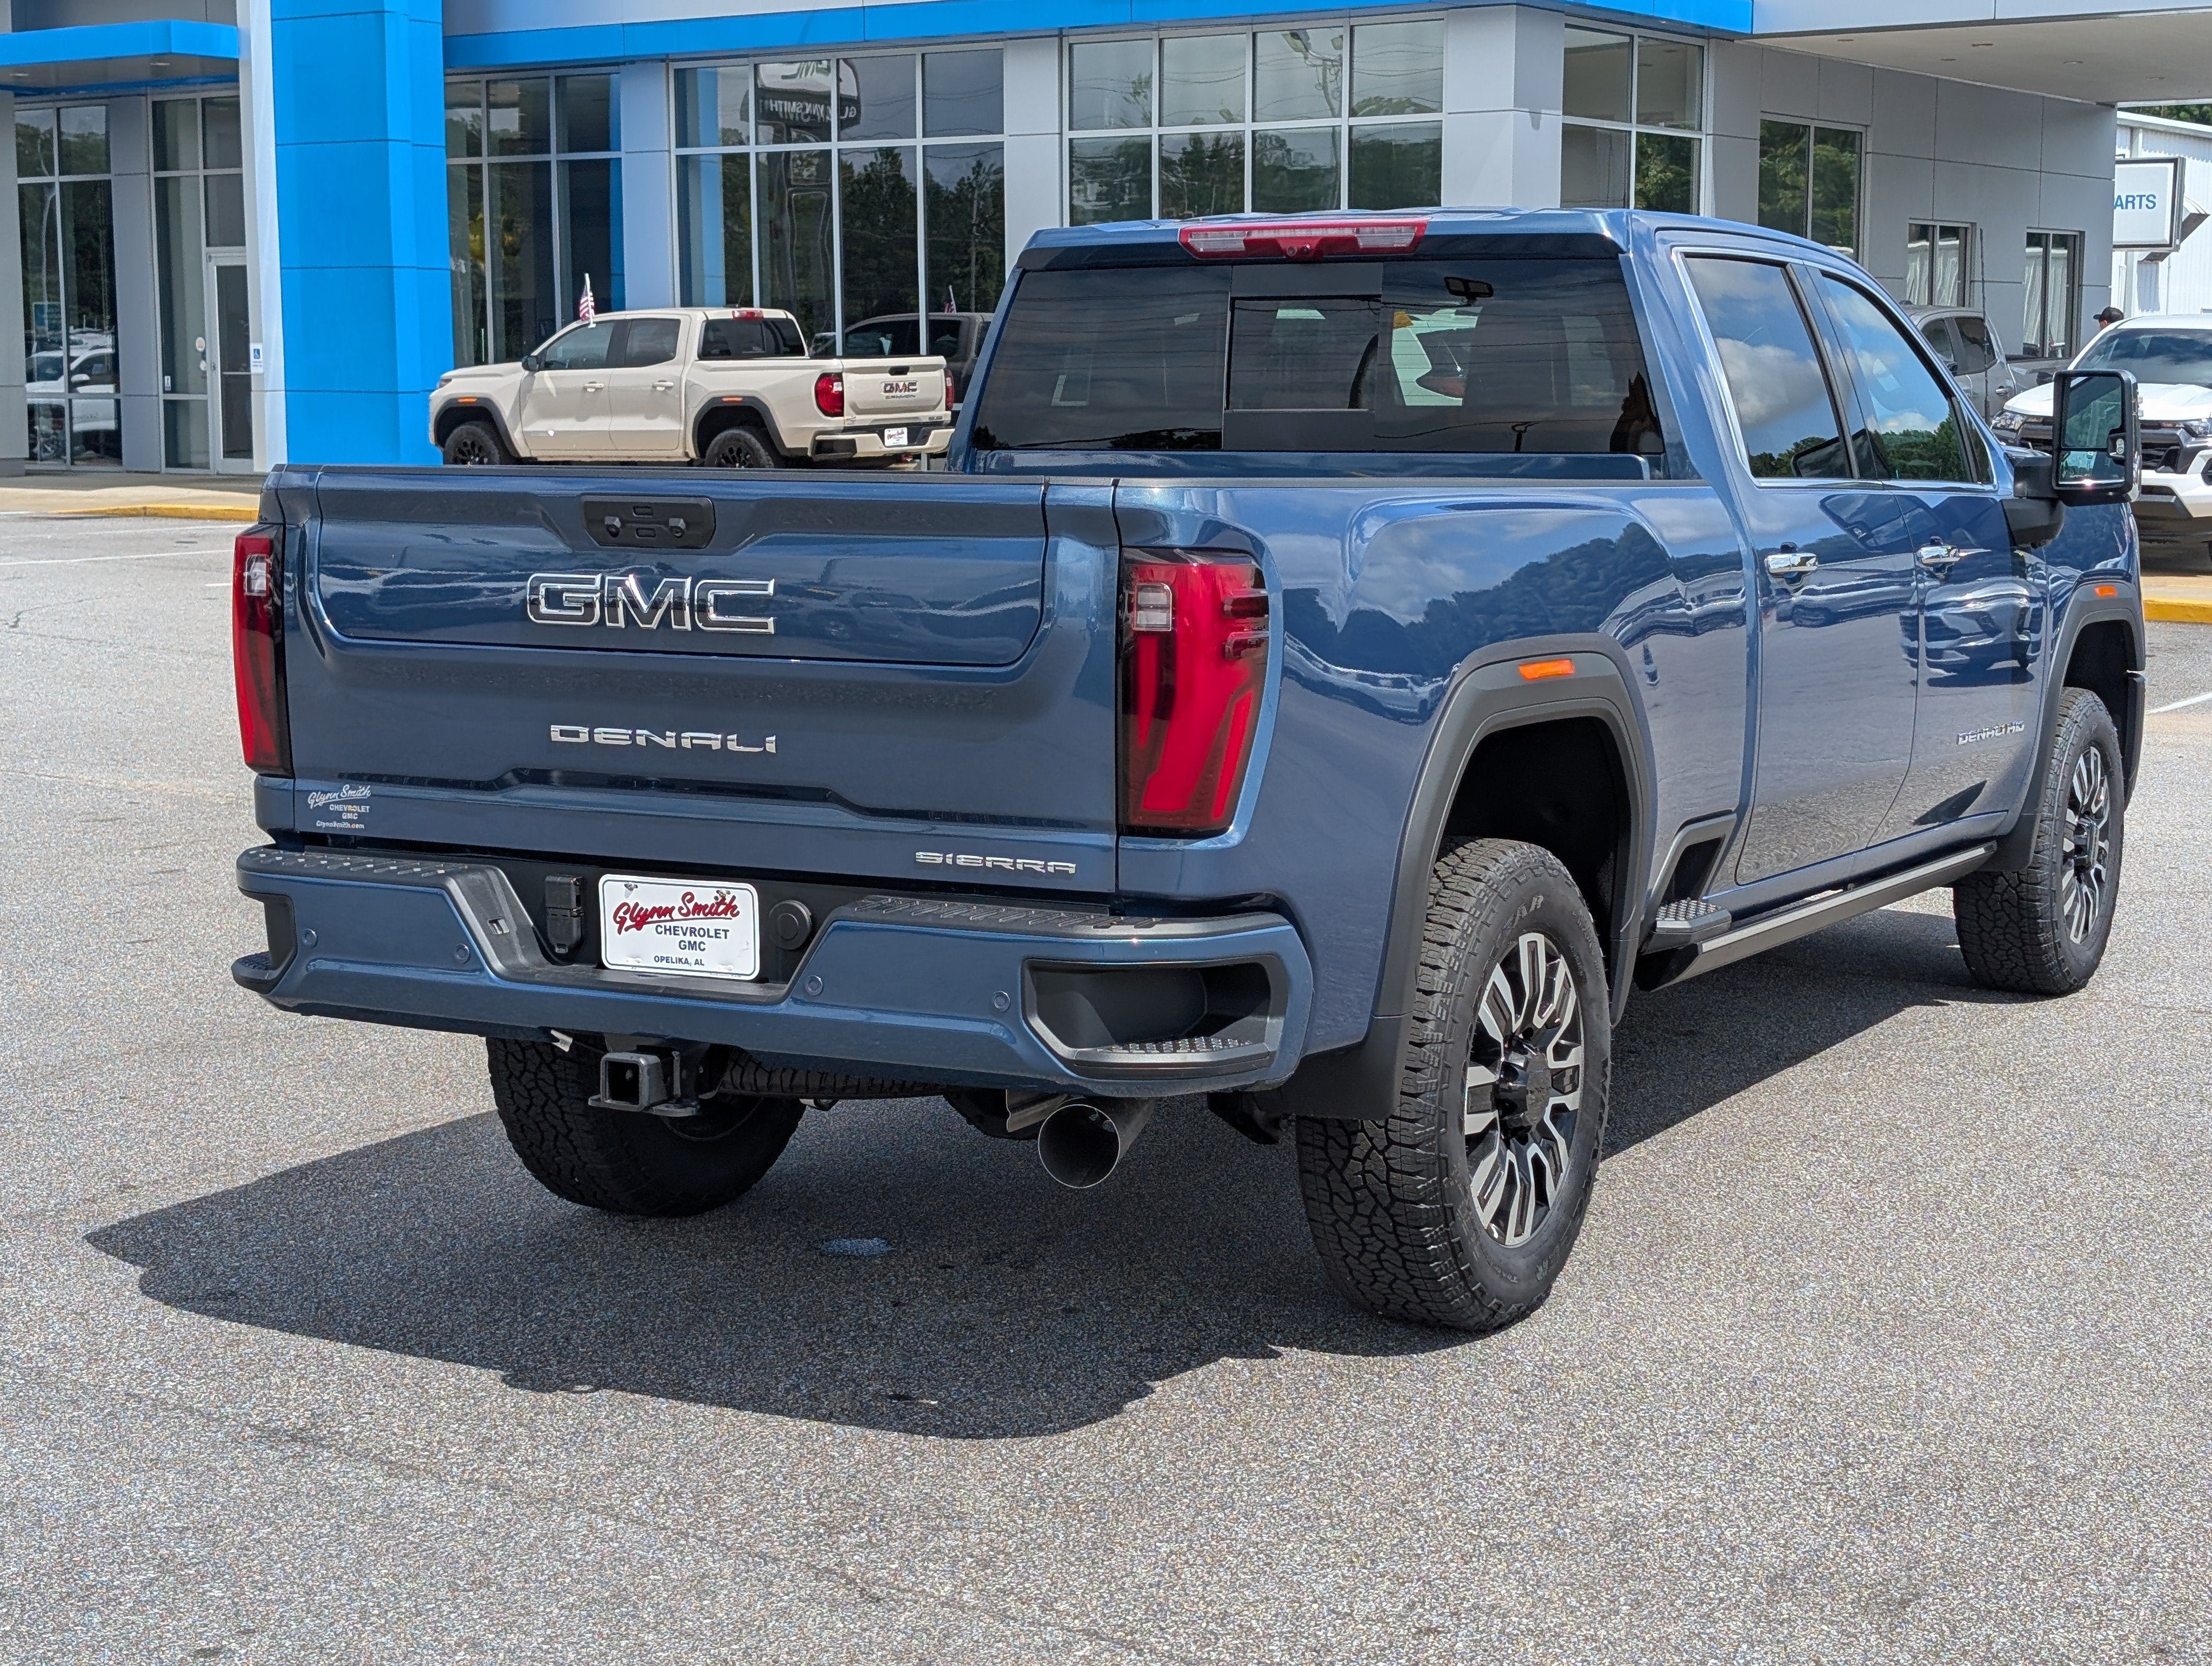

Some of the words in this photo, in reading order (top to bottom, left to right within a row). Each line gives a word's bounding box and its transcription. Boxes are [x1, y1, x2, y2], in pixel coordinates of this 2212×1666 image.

[2113, 194, 2156, 210] ARTS
[884, 381, 917, 393] GMC
[527, 573, 775, 635] GMC
[551, 725, 776, 753] DENALI
[1956, 723, 2006, 745] DENALI
[308, 791, 339, 810] Glynn
[340, 784, 371, 798] Smith
[329, 804, 370, 812] CHEVROLET
[916, 851, 1076, 874] SIERRA
[613, 902, 676, 935] Glynn
[678, 892, 740, 918] Smith
[655, 924, 730, 939] CHEVROLET
[678, 940, 706, 952] GMC
[654, 955, 692, 966] OPELIKA,
[694, 958, 704, 966] AL
